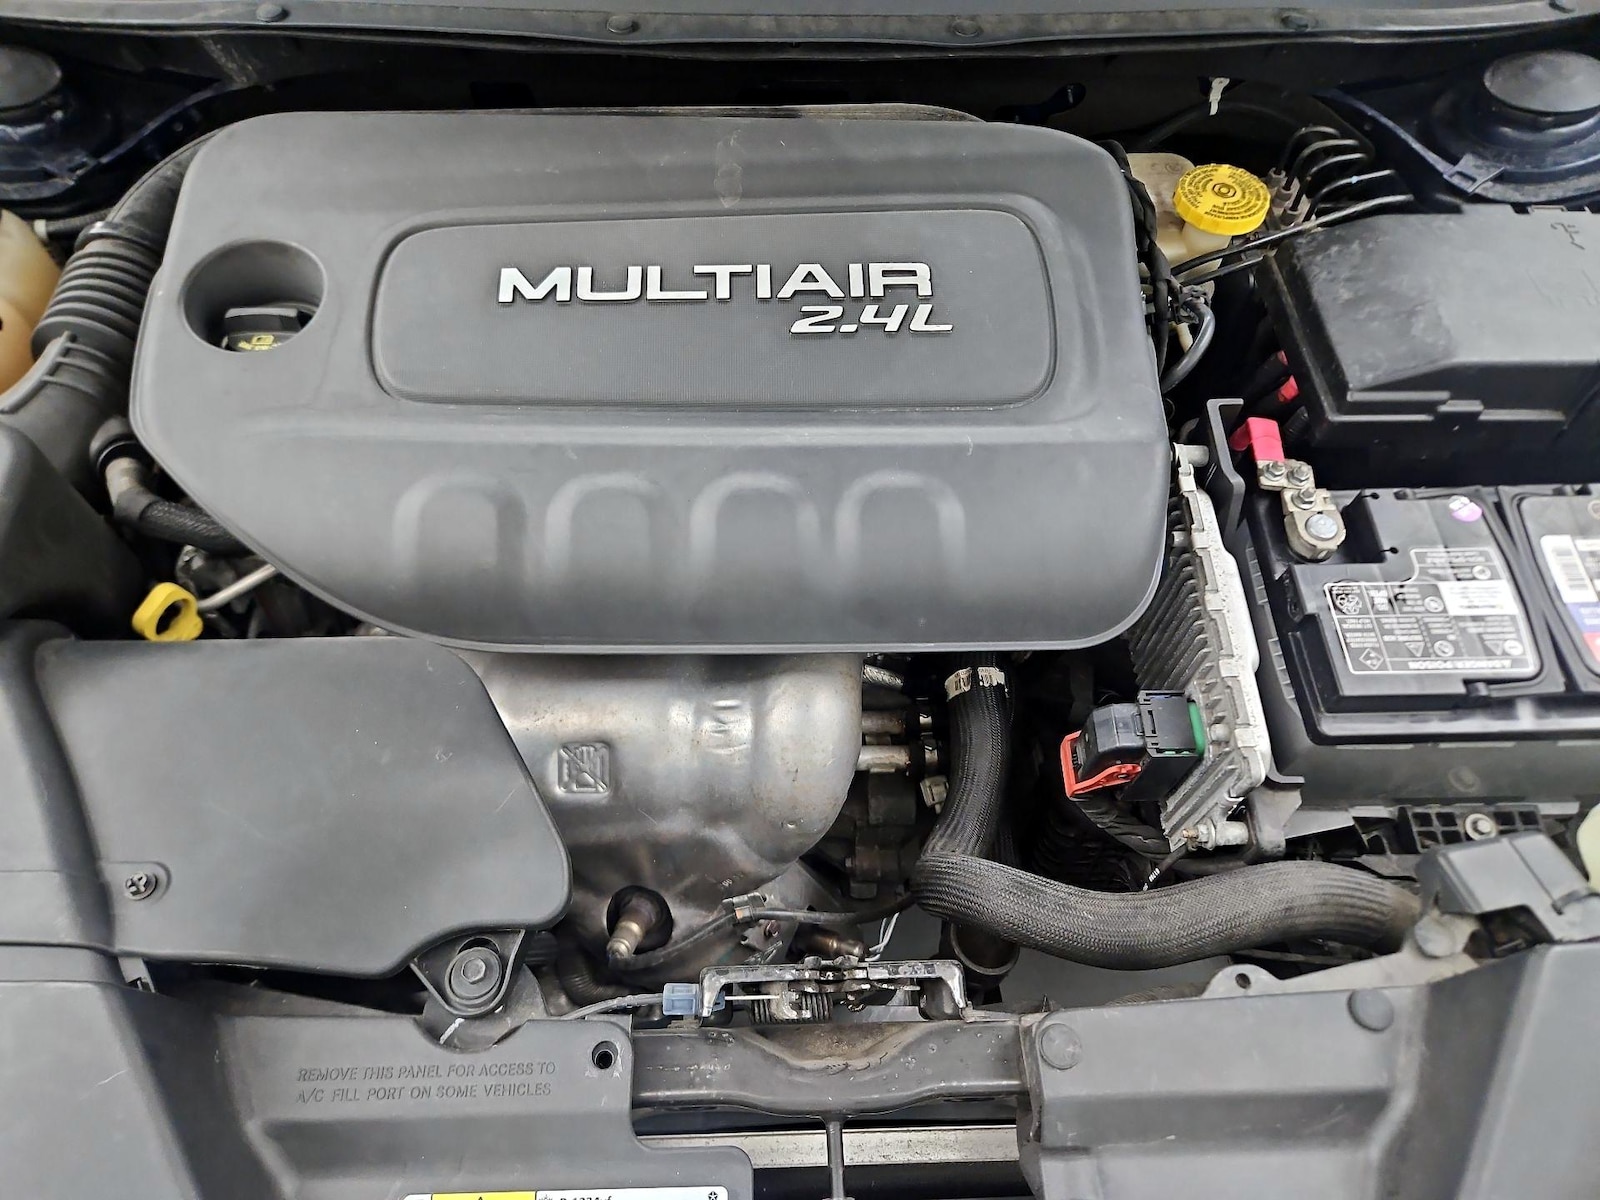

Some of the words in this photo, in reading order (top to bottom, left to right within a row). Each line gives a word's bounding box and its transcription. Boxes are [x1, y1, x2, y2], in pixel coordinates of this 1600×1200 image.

[498, 262, 934, 303] MULTIAIR
[790, 304, 953, 334] 2.4L
[1408, 660, 1454, 671] POISON
[297, 1067, 358, 1081] REMOVE
[362, 1066, 394, 1080] THIS
[398, 1065, 442, 1079] PANEL
[447, 1064, 475, 1078] FOR
[479, 1062, 534, 1077] ACCESS
[538, 1061, 556, 1075] TO
[297, 1087, 324, 1104] A/C
[331, 1087, 360, 1102] FILL
[366, 1086, 405, 1101] PORT
[410, 1086, 432, 1099] ON
[436, 1084, 478, 1099] SOME
[484, 1082, 552, 1097] VEHICLES
